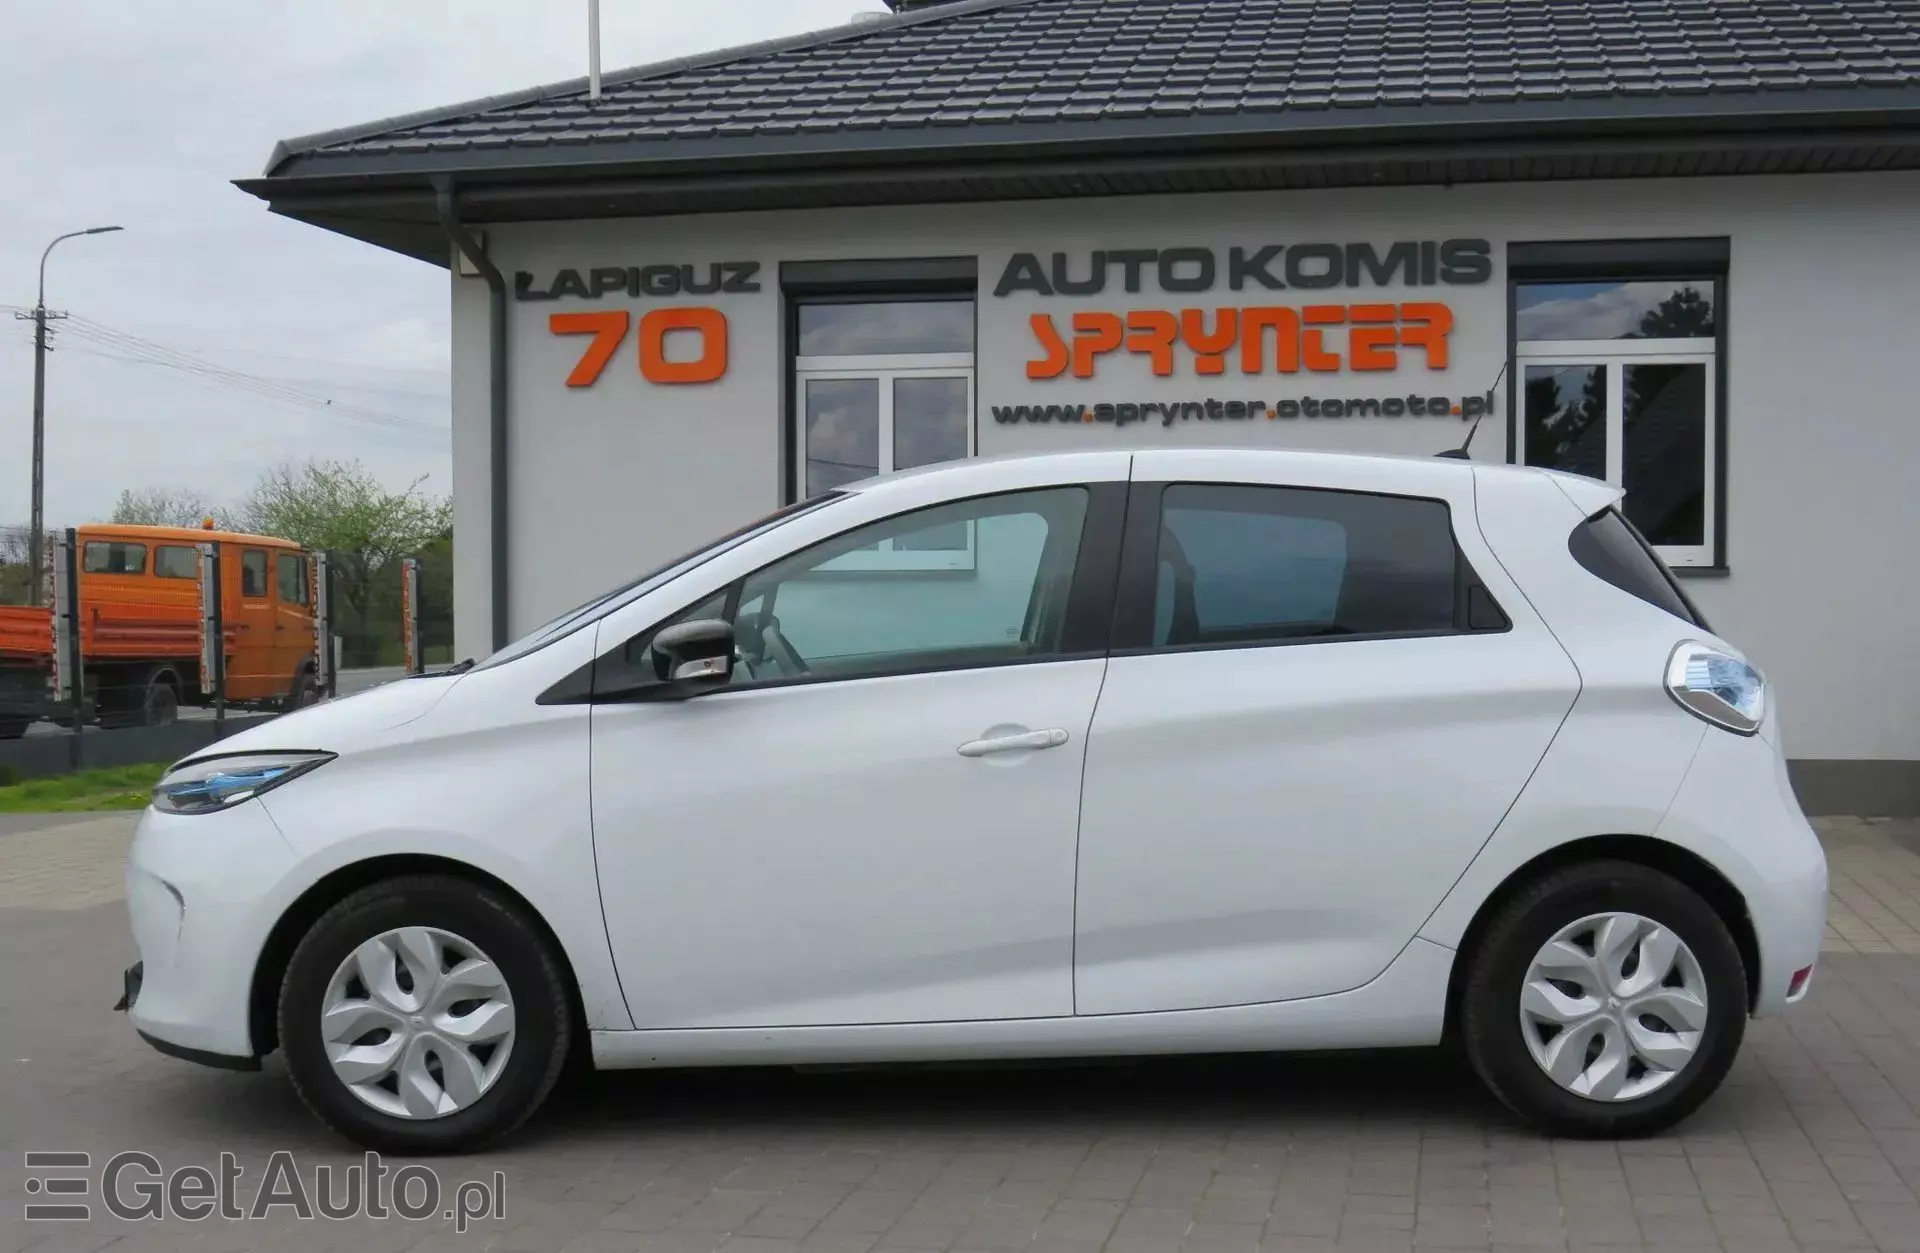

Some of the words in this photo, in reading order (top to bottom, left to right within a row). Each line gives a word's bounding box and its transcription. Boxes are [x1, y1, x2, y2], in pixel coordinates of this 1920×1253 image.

[514, 261, 761, 301] ŁAPIGUZ
[992, 245, 1216, 297] AUTO
[1228, 237, 1493, 291] KOMIS
[549, 307, 729, 387] 70
[1025, 301, 1454, 379] SPRYNTER
[991, 390, 1494, 427] www.sprynter.otomoto.pl
